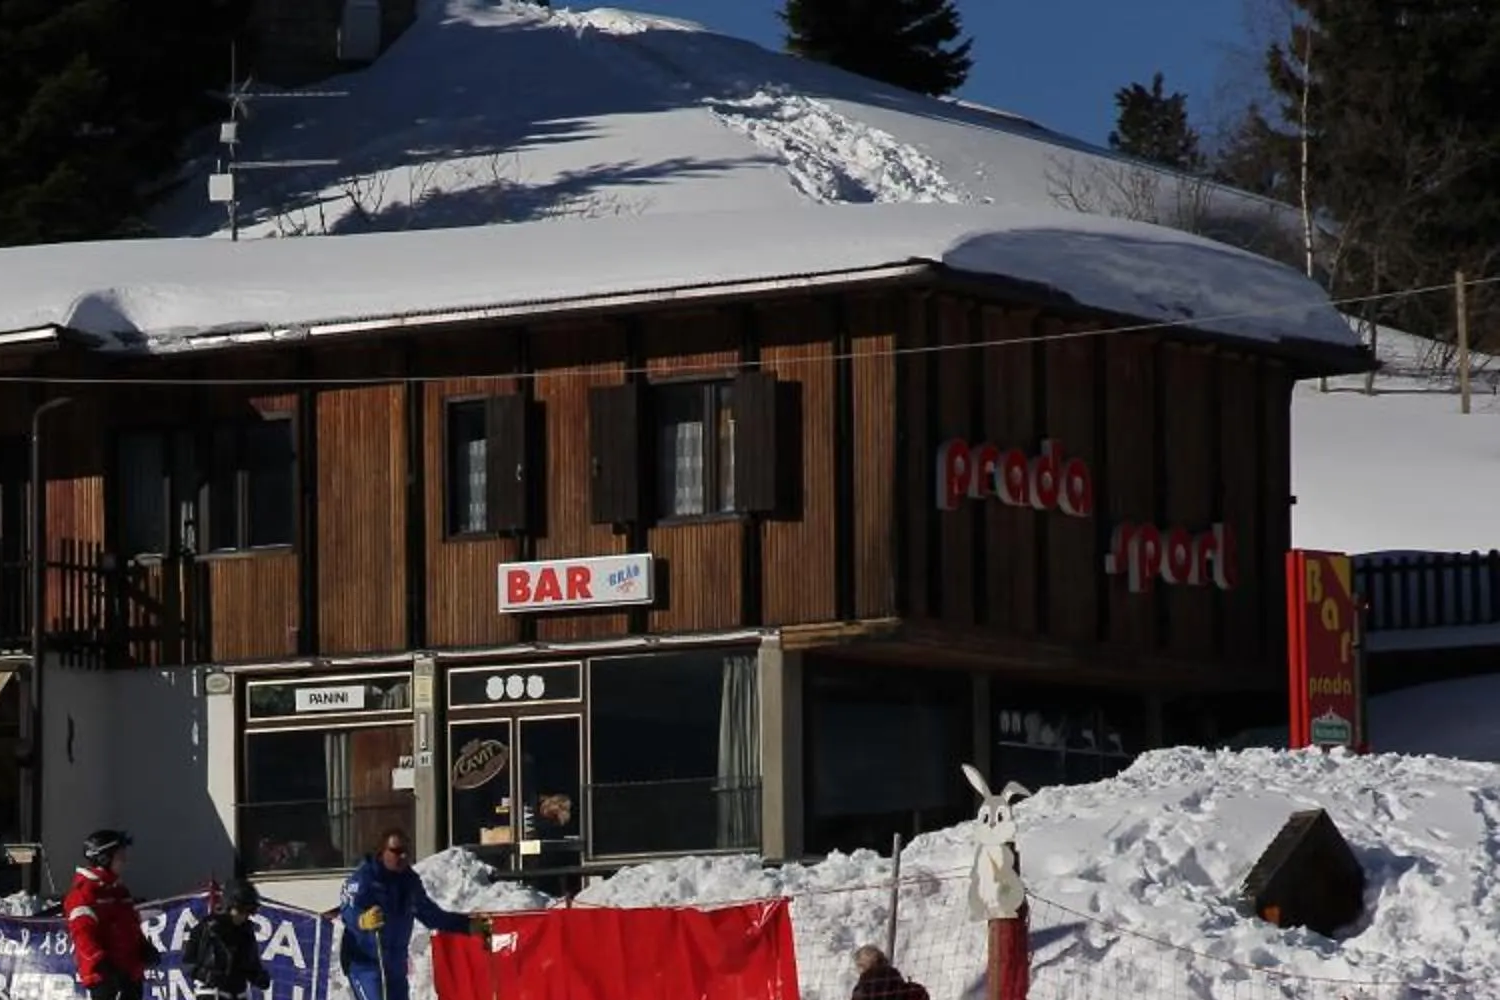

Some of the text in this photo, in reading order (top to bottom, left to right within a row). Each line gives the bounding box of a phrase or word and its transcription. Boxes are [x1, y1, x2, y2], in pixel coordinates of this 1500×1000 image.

[936, 437, 1093, 518] prada
[507, 565, 593, 604] BAR
[309, 691, 349, 705] PANINI
[1309, 672, 1351, 698] prada
